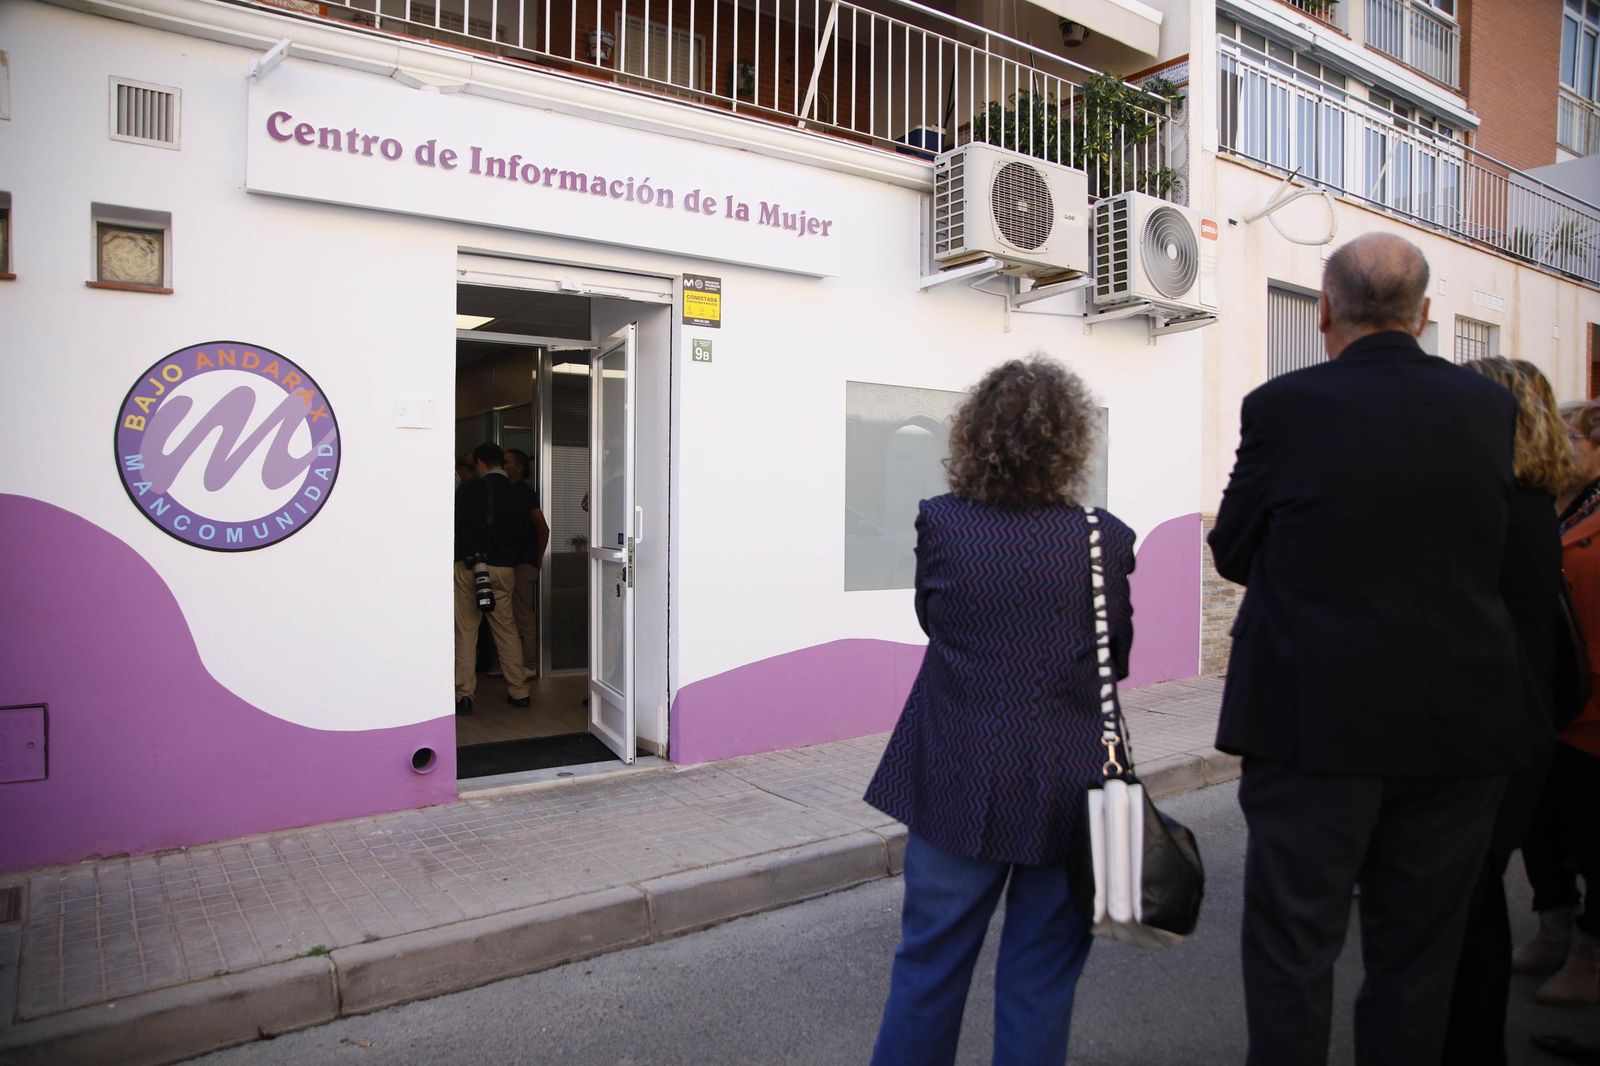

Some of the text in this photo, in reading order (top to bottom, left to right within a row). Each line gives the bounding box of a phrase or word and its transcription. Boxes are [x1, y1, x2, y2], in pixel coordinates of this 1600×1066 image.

[267, 111, 833, 238] Centro de Información de la Mujer
[686, 294, 718, 303] CONECTADA
[123, 349, 329, 432] BAJO ANDARAX
[695, 347, 710, 361] 9B
[125, 443, 334, 543] MANCOMUNIDAD
